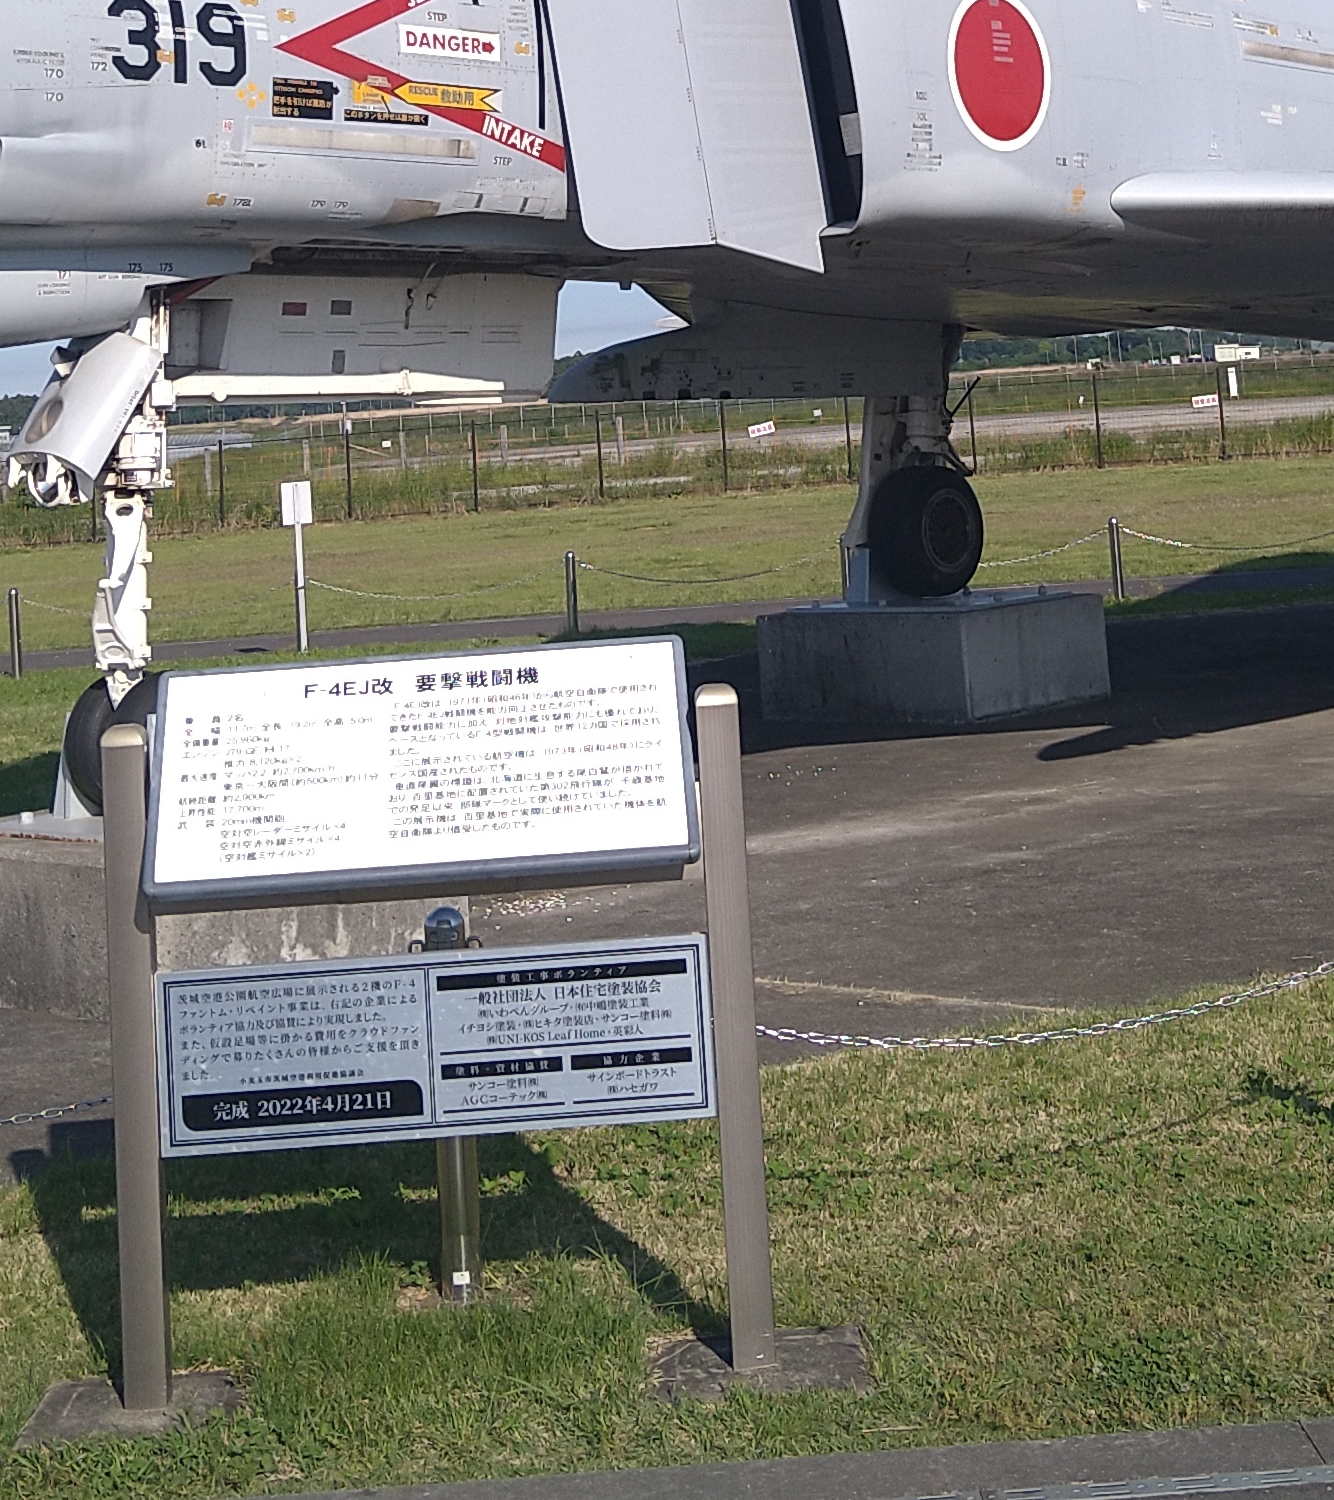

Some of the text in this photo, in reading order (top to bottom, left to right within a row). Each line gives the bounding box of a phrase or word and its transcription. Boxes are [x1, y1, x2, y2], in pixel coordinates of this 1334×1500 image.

[426, 11, 447, 22] STEP
[405, 30, 482, 55] DANGER
[90, 61, 108, 72] 172
[44, 68, 64, 78] 170
[45, 91, 64, 102] 170
[408, 85, 439, 97] RESCUE
[481, 114, 544, 158] INTAKE
[493, 155, 513, 166] STEP
[304, 667, 539, 699] F-4EJ改 要撃戦闘機
[465, 978, 660, 1005] 一般社団法人 日本住宅塗装協会
[547, 1028, 571, 1041] Leaf
[213, 1090, 390, 1120] 完成 2022年4月21日
